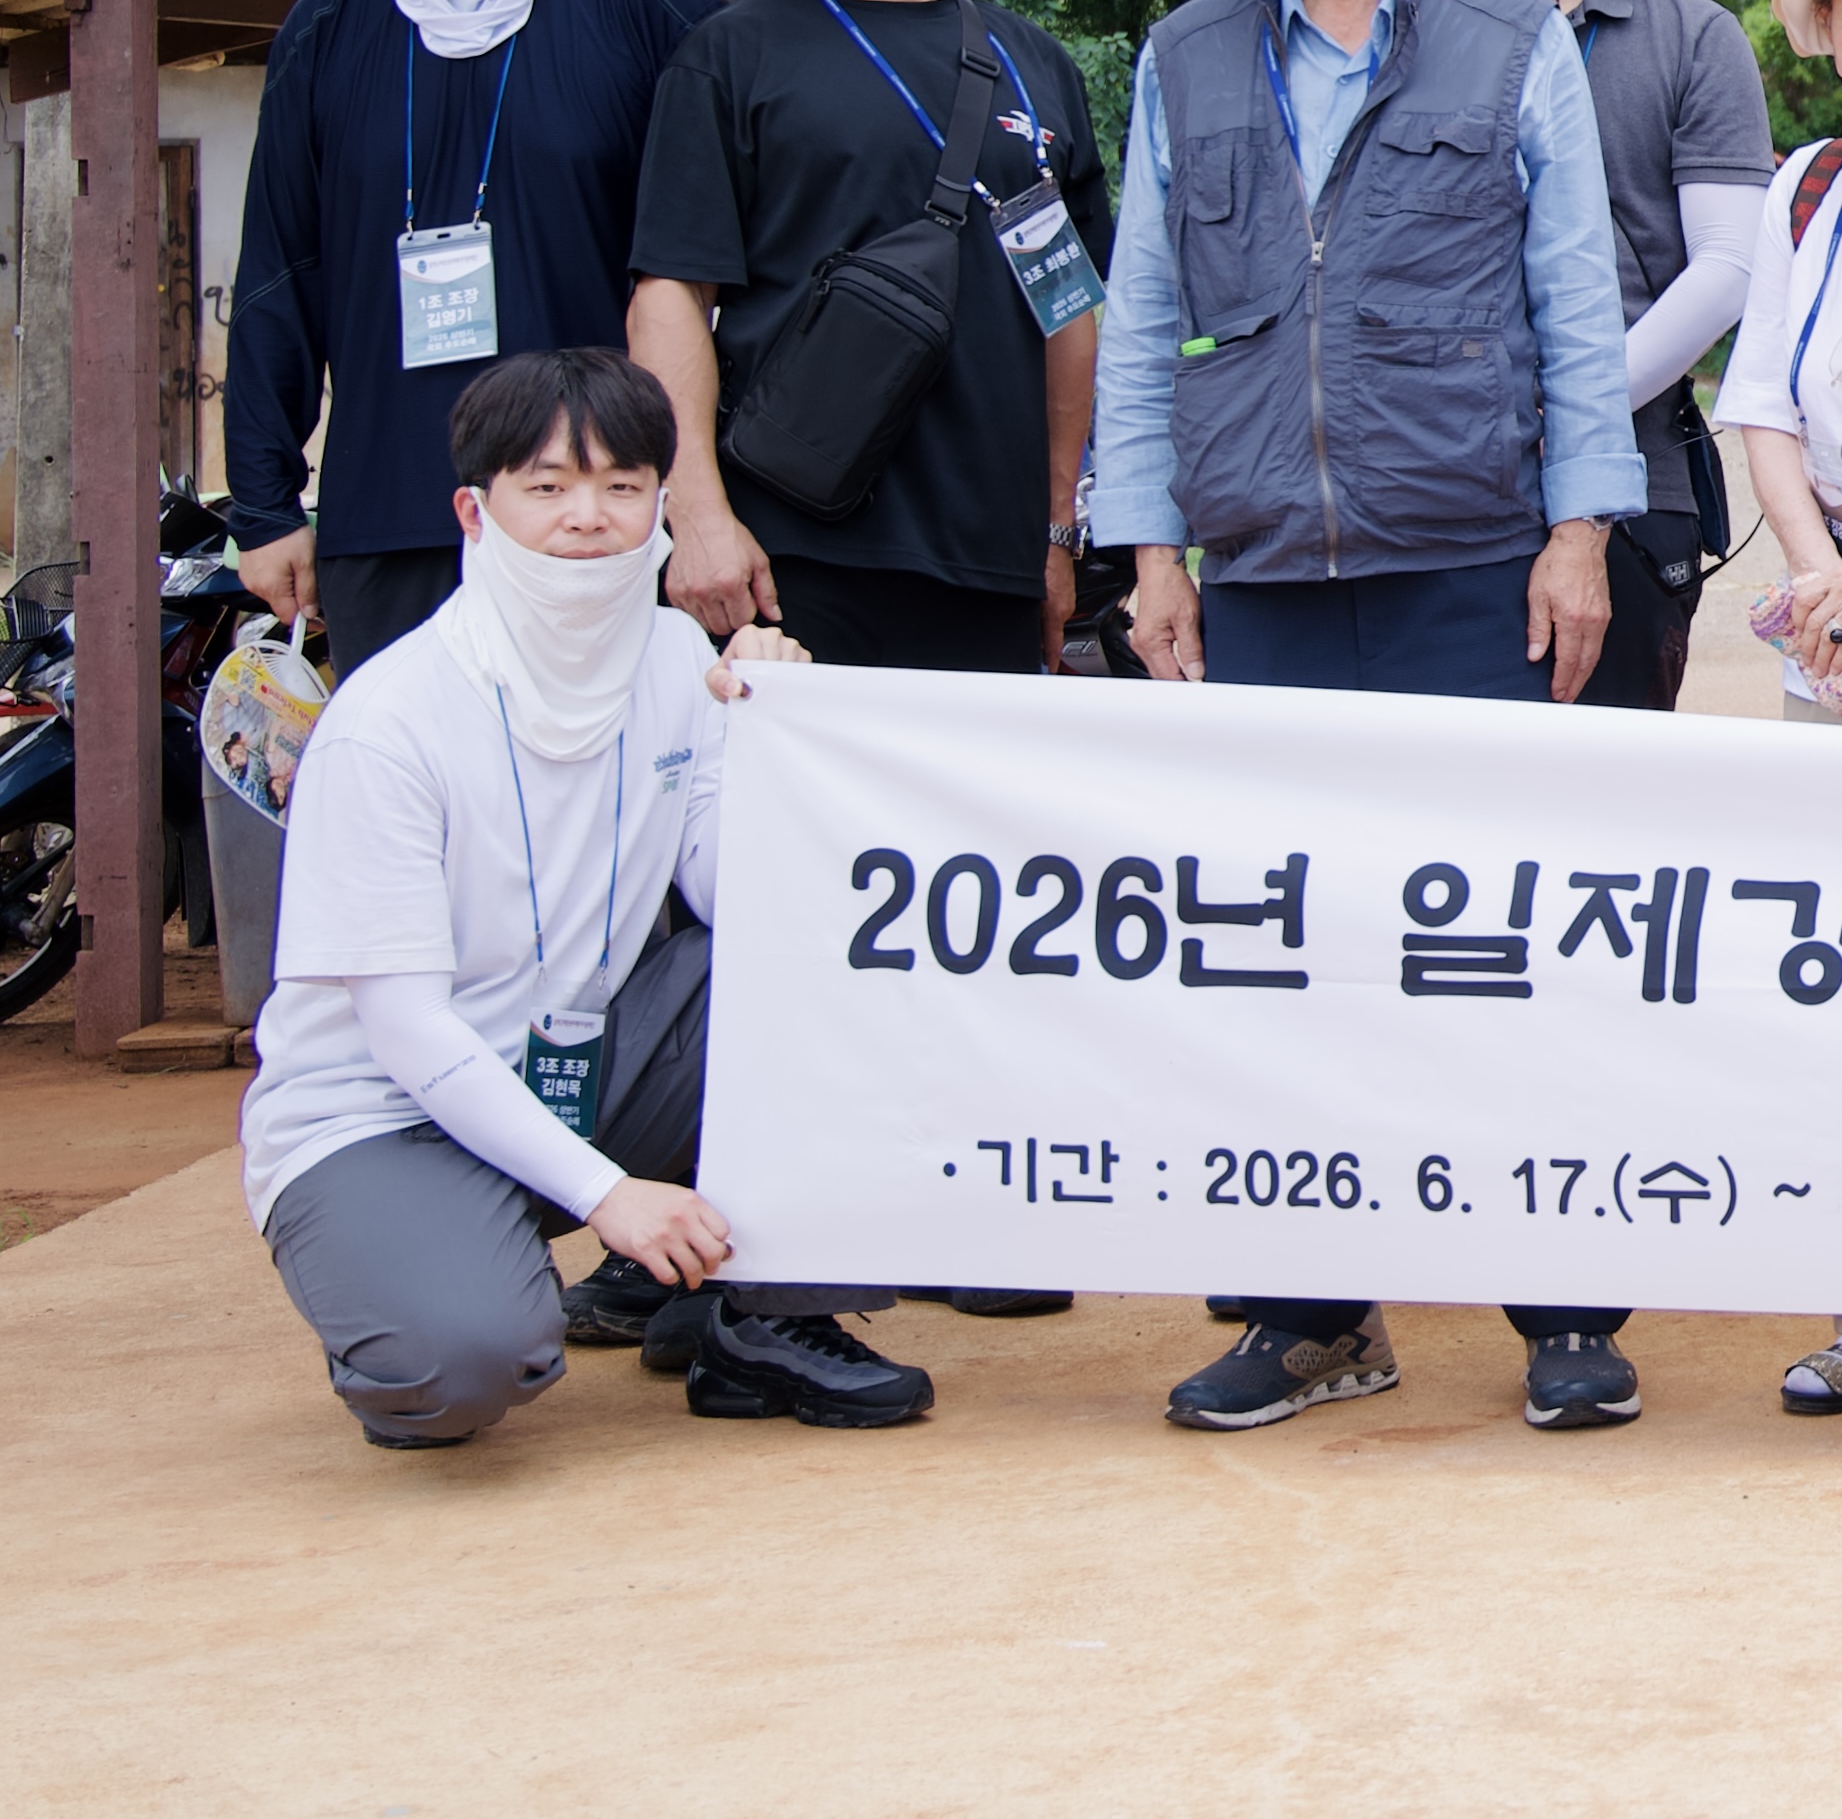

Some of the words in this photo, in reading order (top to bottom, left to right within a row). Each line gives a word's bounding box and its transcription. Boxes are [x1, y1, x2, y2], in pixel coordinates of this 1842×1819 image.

[1022, 263, 1046, 286] 3조
[418, 293, 444, 311] 1조
[447, 286, 480, 307] 조장
[425, 306, 474, 330] 김영기
[848, 848, 1309, 989] 2026년
[535, 1056, 560, 1075] 3조
[562, 1058, 590, 1078] 조장
[541, 1077, 582, 1099] 김현목
[1205, 1148, 1380, 1210] 2026.
[1418, 1155, 1471, 1213] 6.
[1512, 1153, 1737, 1226] 17.(수)
